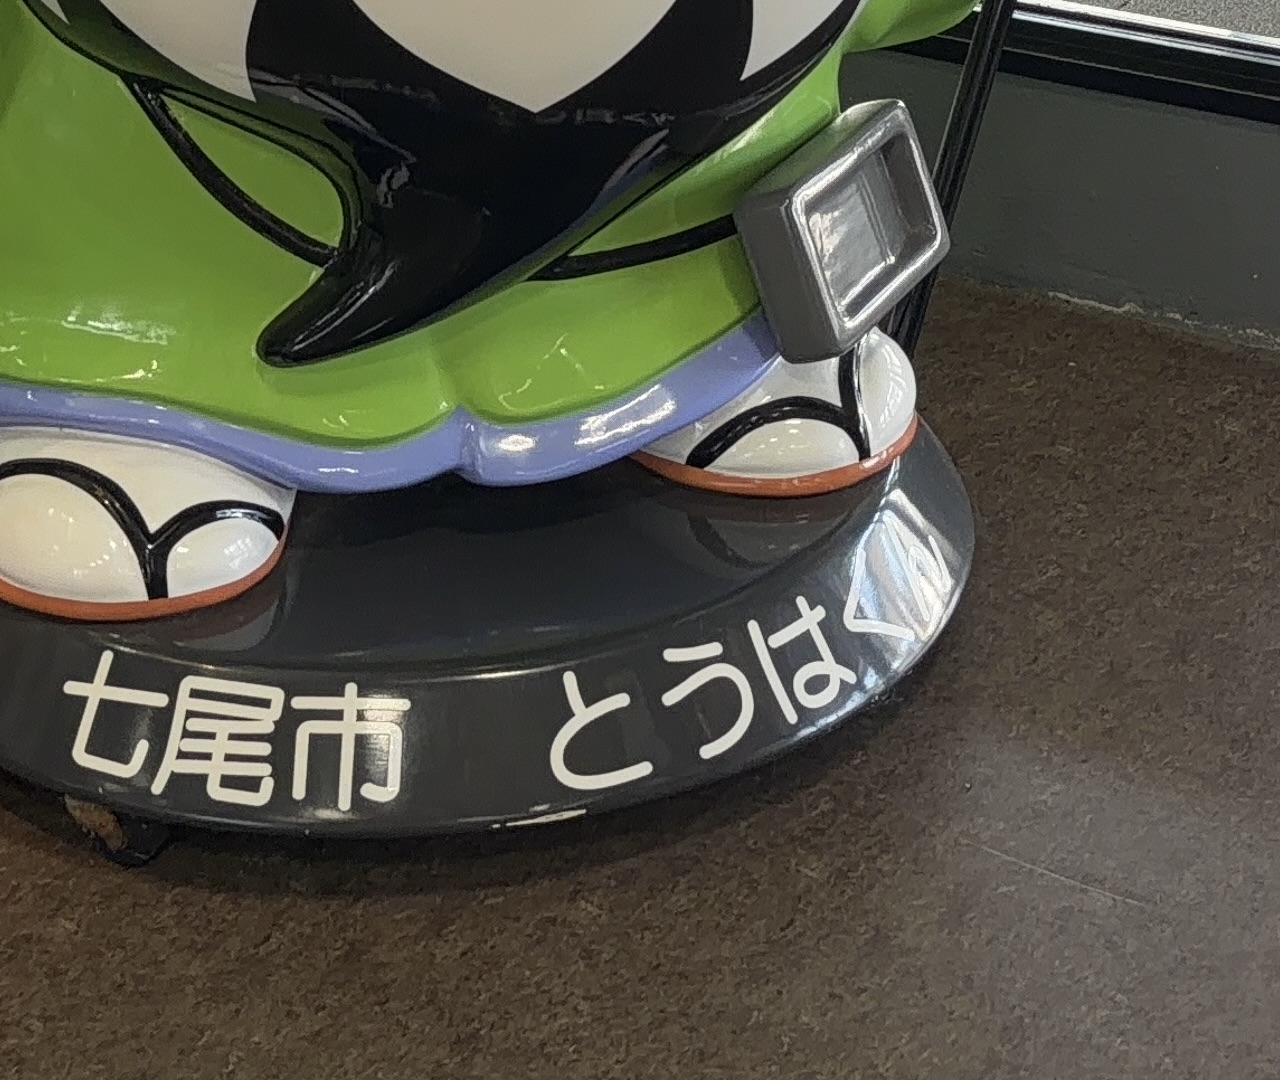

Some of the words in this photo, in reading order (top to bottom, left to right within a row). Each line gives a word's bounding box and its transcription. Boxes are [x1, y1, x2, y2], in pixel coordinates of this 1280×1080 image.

[63, 650, 411, 811] 七尾市
[550, 508, 952, 791] とうはくん
